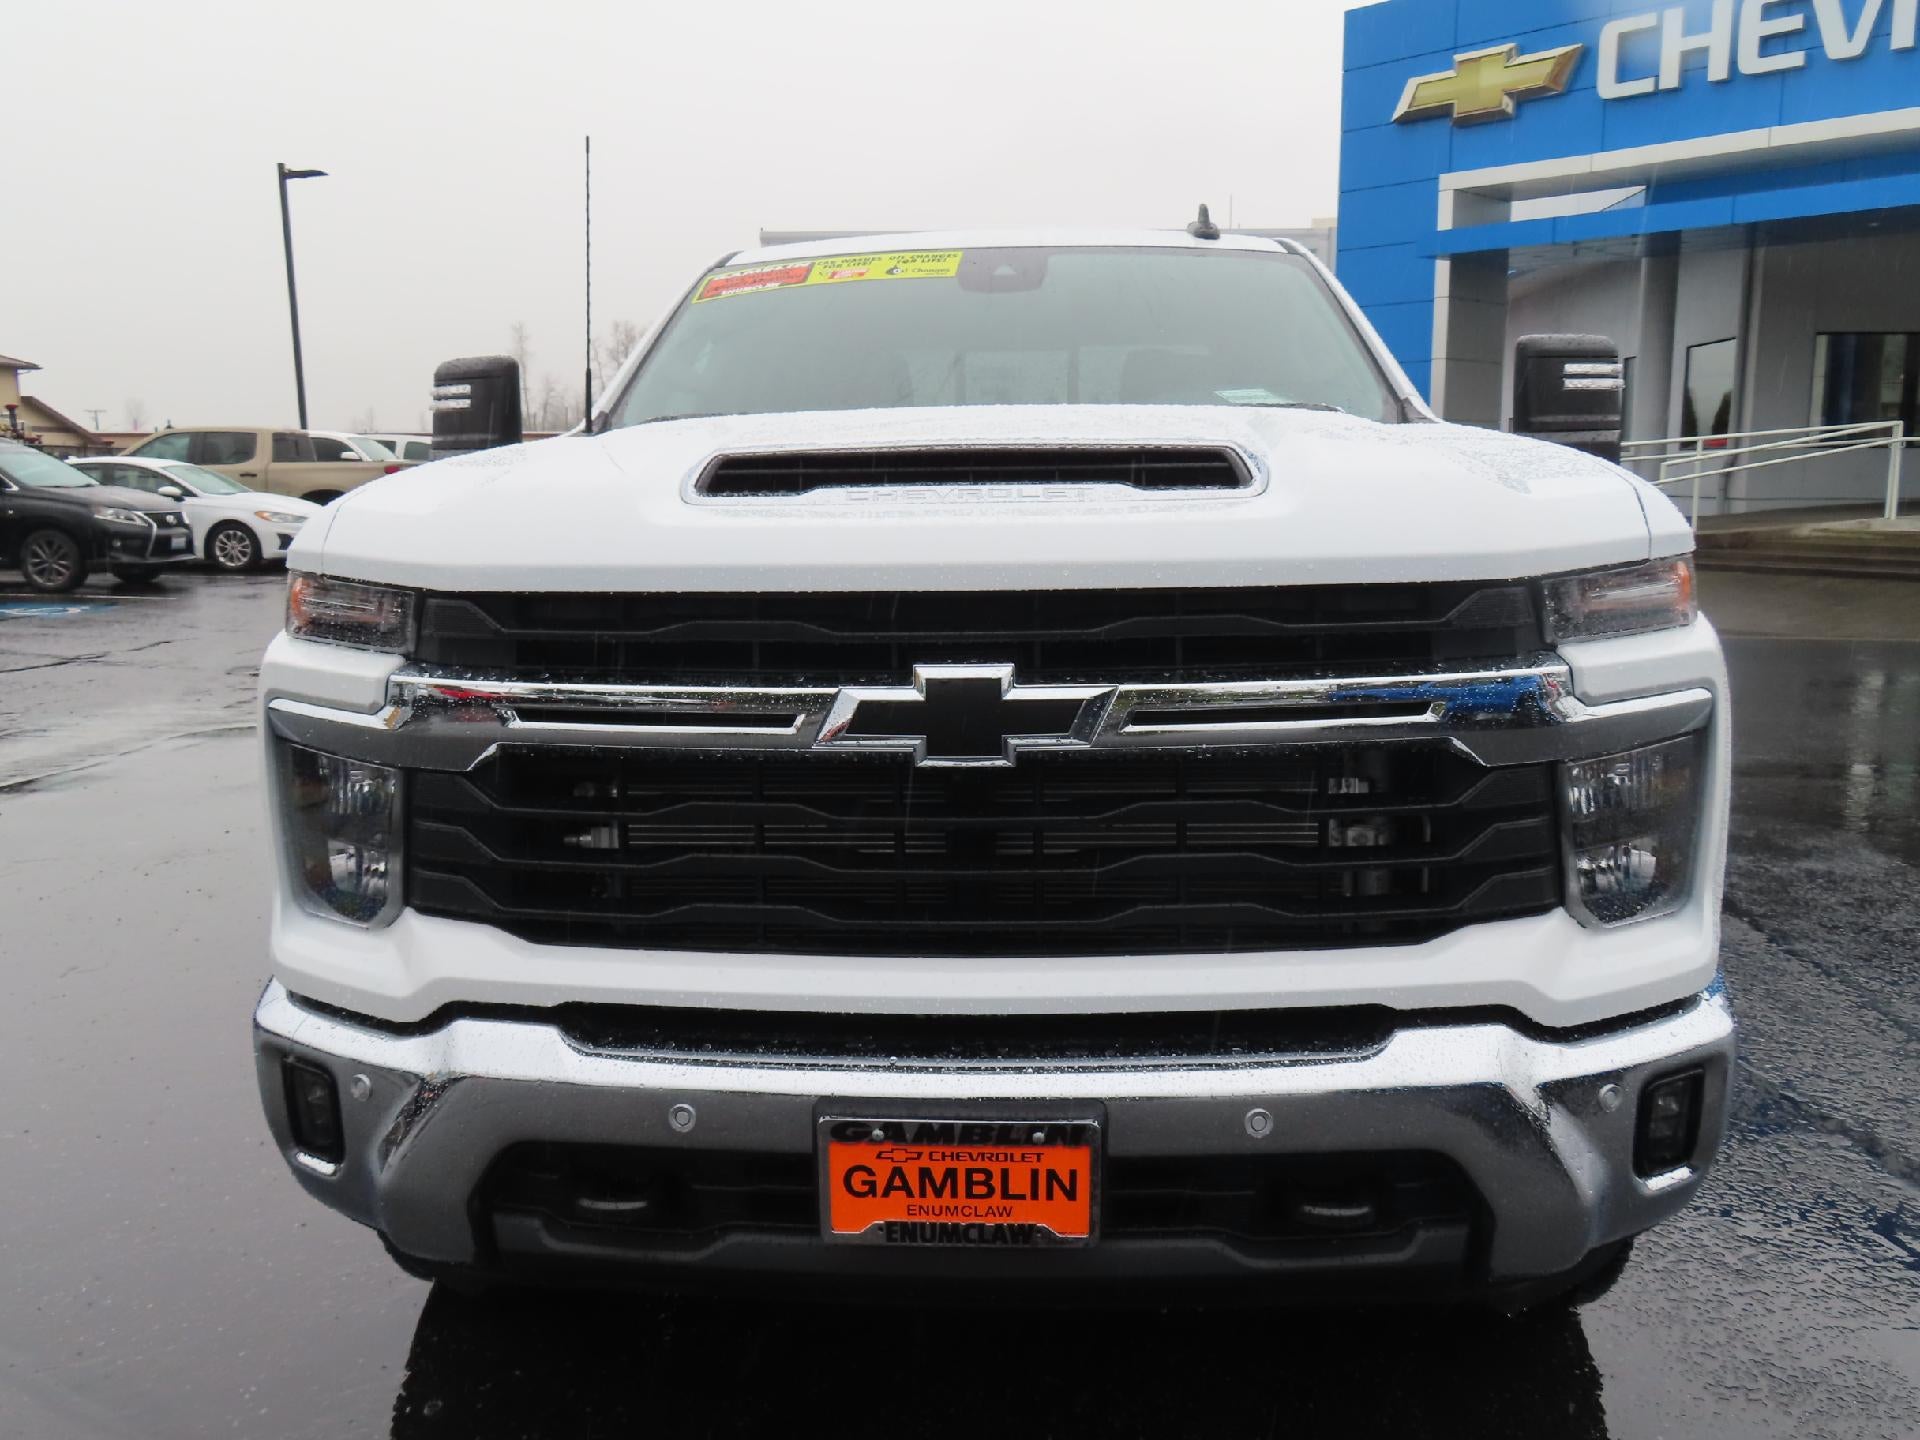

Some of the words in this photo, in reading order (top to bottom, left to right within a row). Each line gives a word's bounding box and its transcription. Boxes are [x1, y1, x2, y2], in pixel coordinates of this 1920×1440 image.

[845, 487, 1094, 503] CHEVROLET
[830, 1121, 1088, 1146] GAMBLIN
[928, 1151, 1044, 1163] CHEVROLET
[842, 1164, 1078, 1202] GAMBLIN
[906, 1204, 1013, 1218] ENUMCLAW
[885, 1222, 1034, 1244] ENUMCLAW
